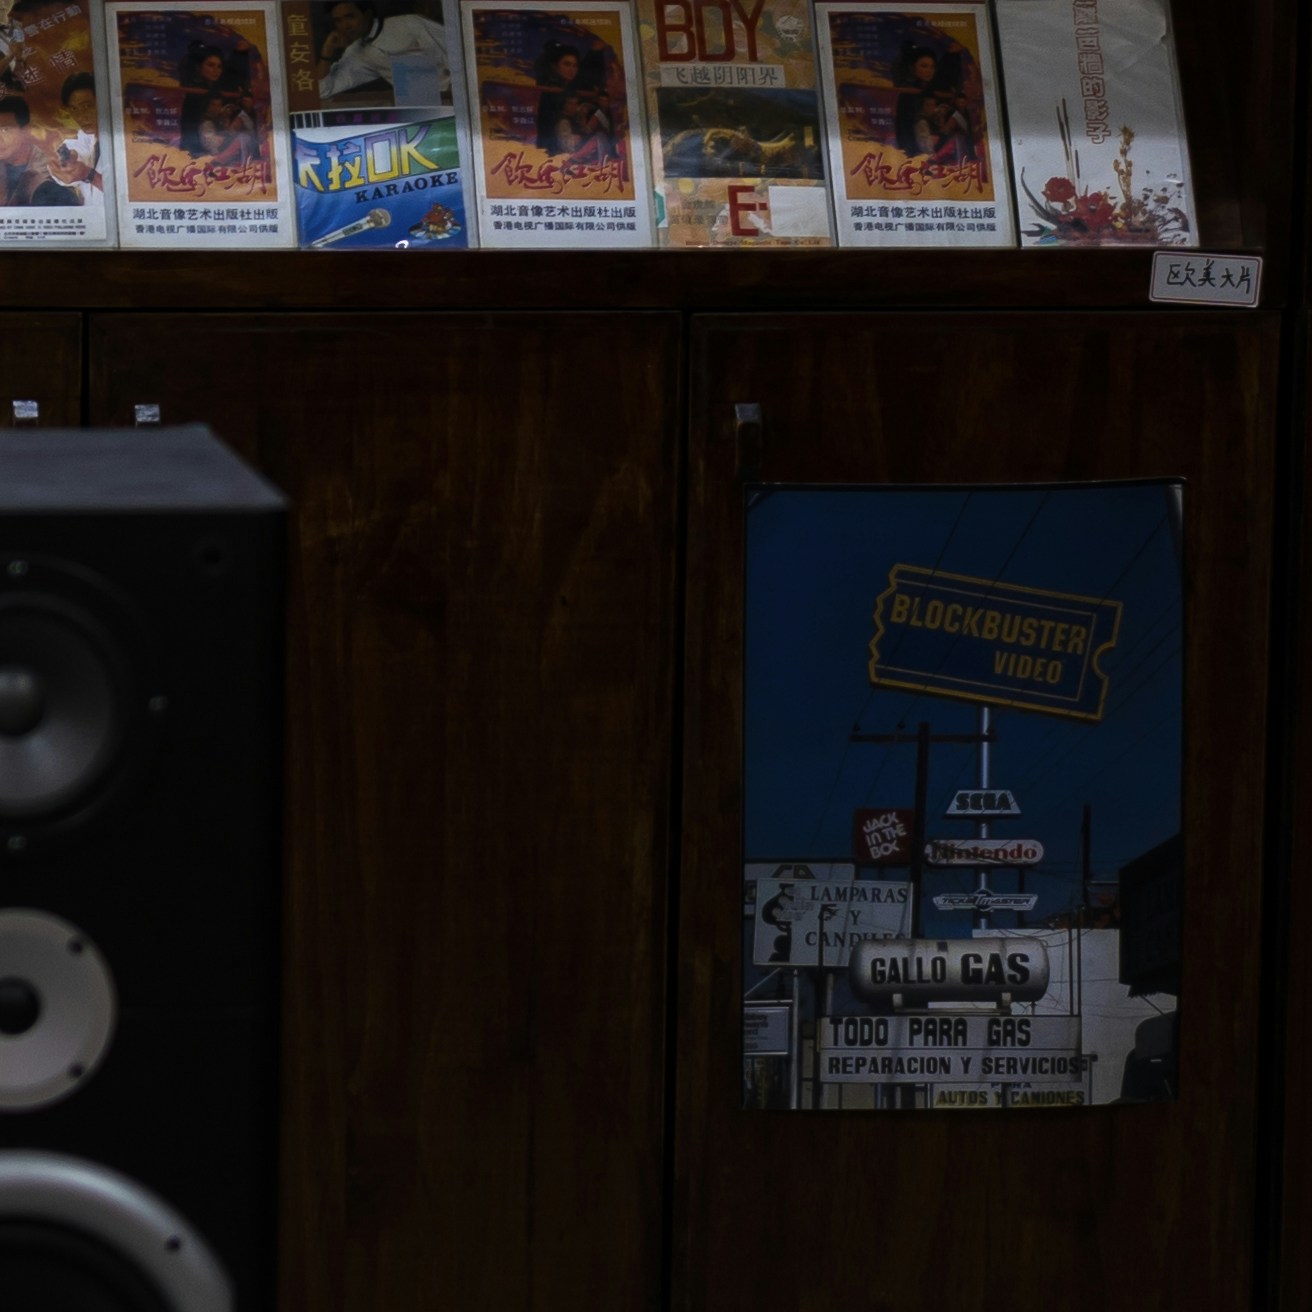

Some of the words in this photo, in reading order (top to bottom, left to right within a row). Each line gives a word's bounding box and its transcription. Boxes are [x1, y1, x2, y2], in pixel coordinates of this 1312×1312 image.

[665, 64, 780, 87] 飞越阴阳界
[355, 171, 459, 204] KARAOKE
[131, 208, 278, 222] 湖北音像艺术出版社出版
[489, 205, 636, 219] 湖北音像艺术出版社出版
[850, 206, 998, 221] 湖北音像艺术出版社出版
[1167, 259, 1251, 295] 欧美大片
[889, 593, 1088, 656] BLOCKBUSTER
[992, 649, 1064, 686] VIDEO
[955, 793, 1011, 811] SEGA
[863, 811, 898, 834] JACK
[883, 822, 908, 842] THE
[869, 839, 899, 860] BOX
[930, 842, 1038, 863] Nintendo
[810, 885, 908, 904] LAMPARAS
[849, 909, 862, 926] Y
[870, 955, 947, 987] GALLO
[960, 952, 1032, 987] GAS
[830, 1017, 888, 1048] TODO
[908, 1017, 968, 1048] PARA
[987, 1017, 1032, 1048] GAS
[828, 1056, 953, 1076] REPARACION
[959, 1056, 972, 1076] Y
[981, 1055, 1082, 1076] SERVICIOS
[937, 1089, 994, 1106] AUTOS
[1010, 1089, 1086, 1106] CAMIONES
